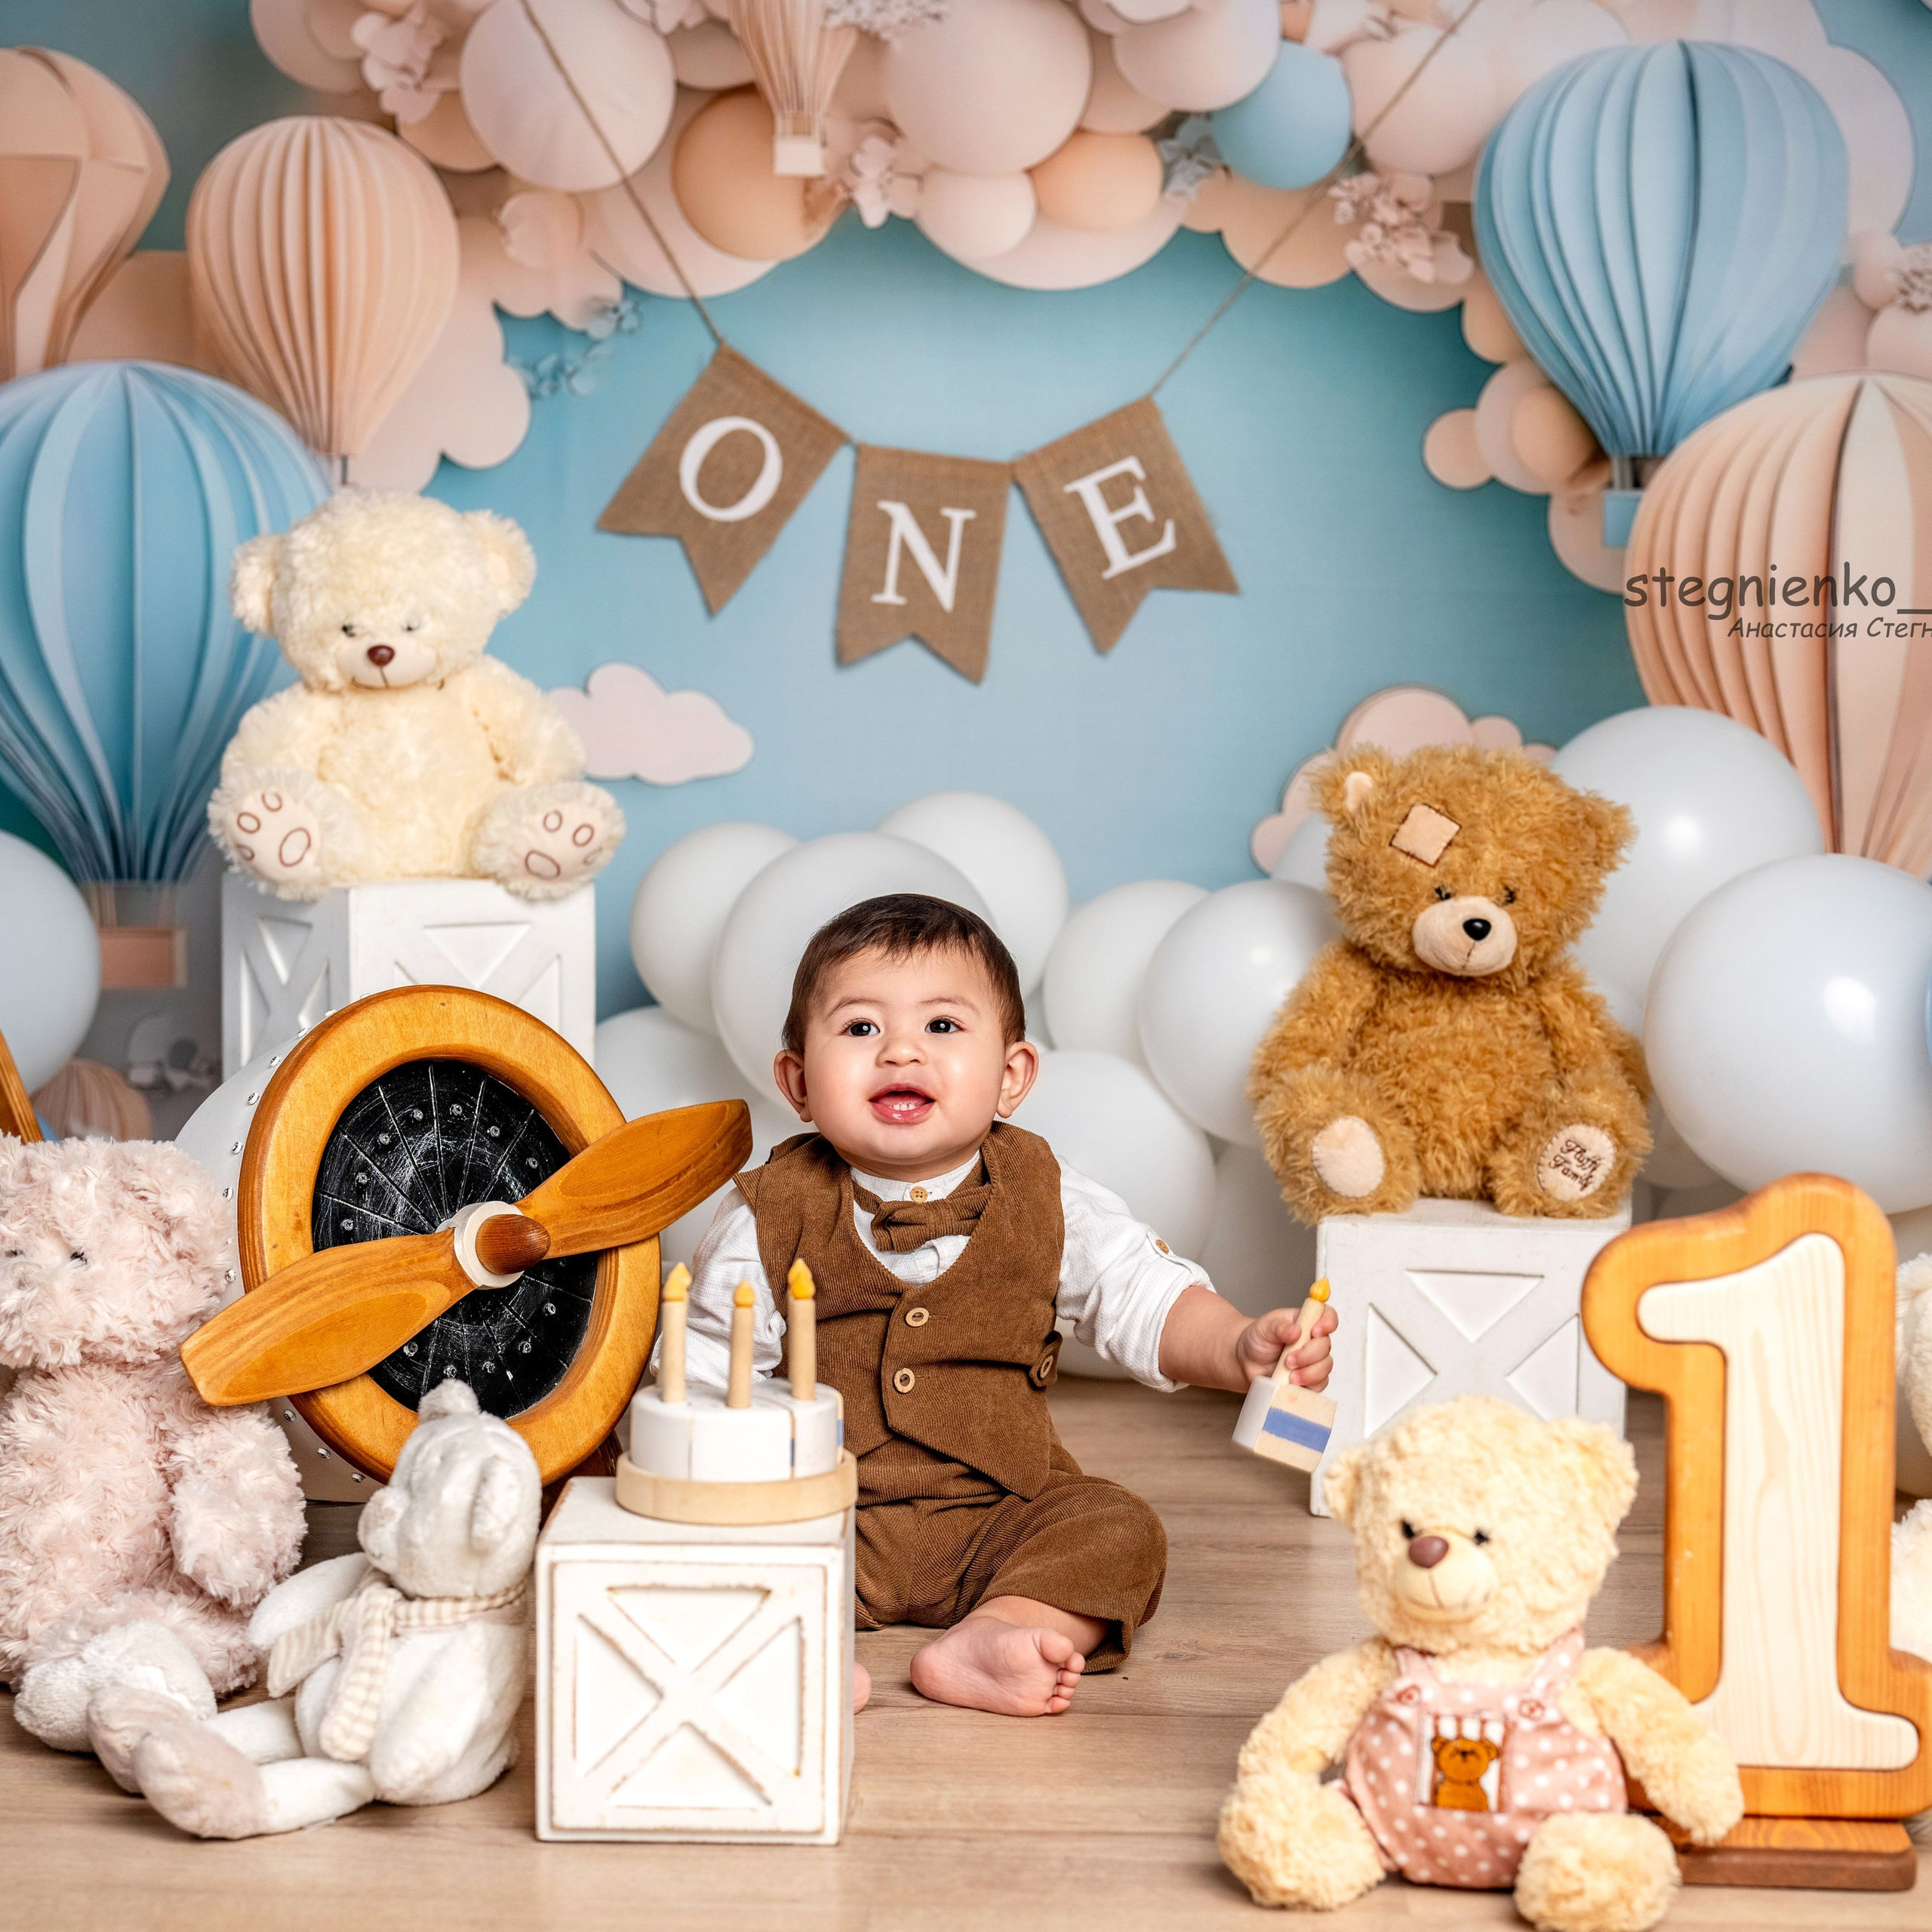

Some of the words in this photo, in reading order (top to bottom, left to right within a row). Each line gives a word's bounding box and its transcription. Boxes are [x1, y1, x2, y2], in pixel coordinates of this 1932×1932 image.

[678, 416, 1177, 612] ONE
[1549, 1155, 1592, 1191] Family
[1561, 1140, 1601, 1175] Fluffy
[1585, 1174, 1932, 1817] 1
